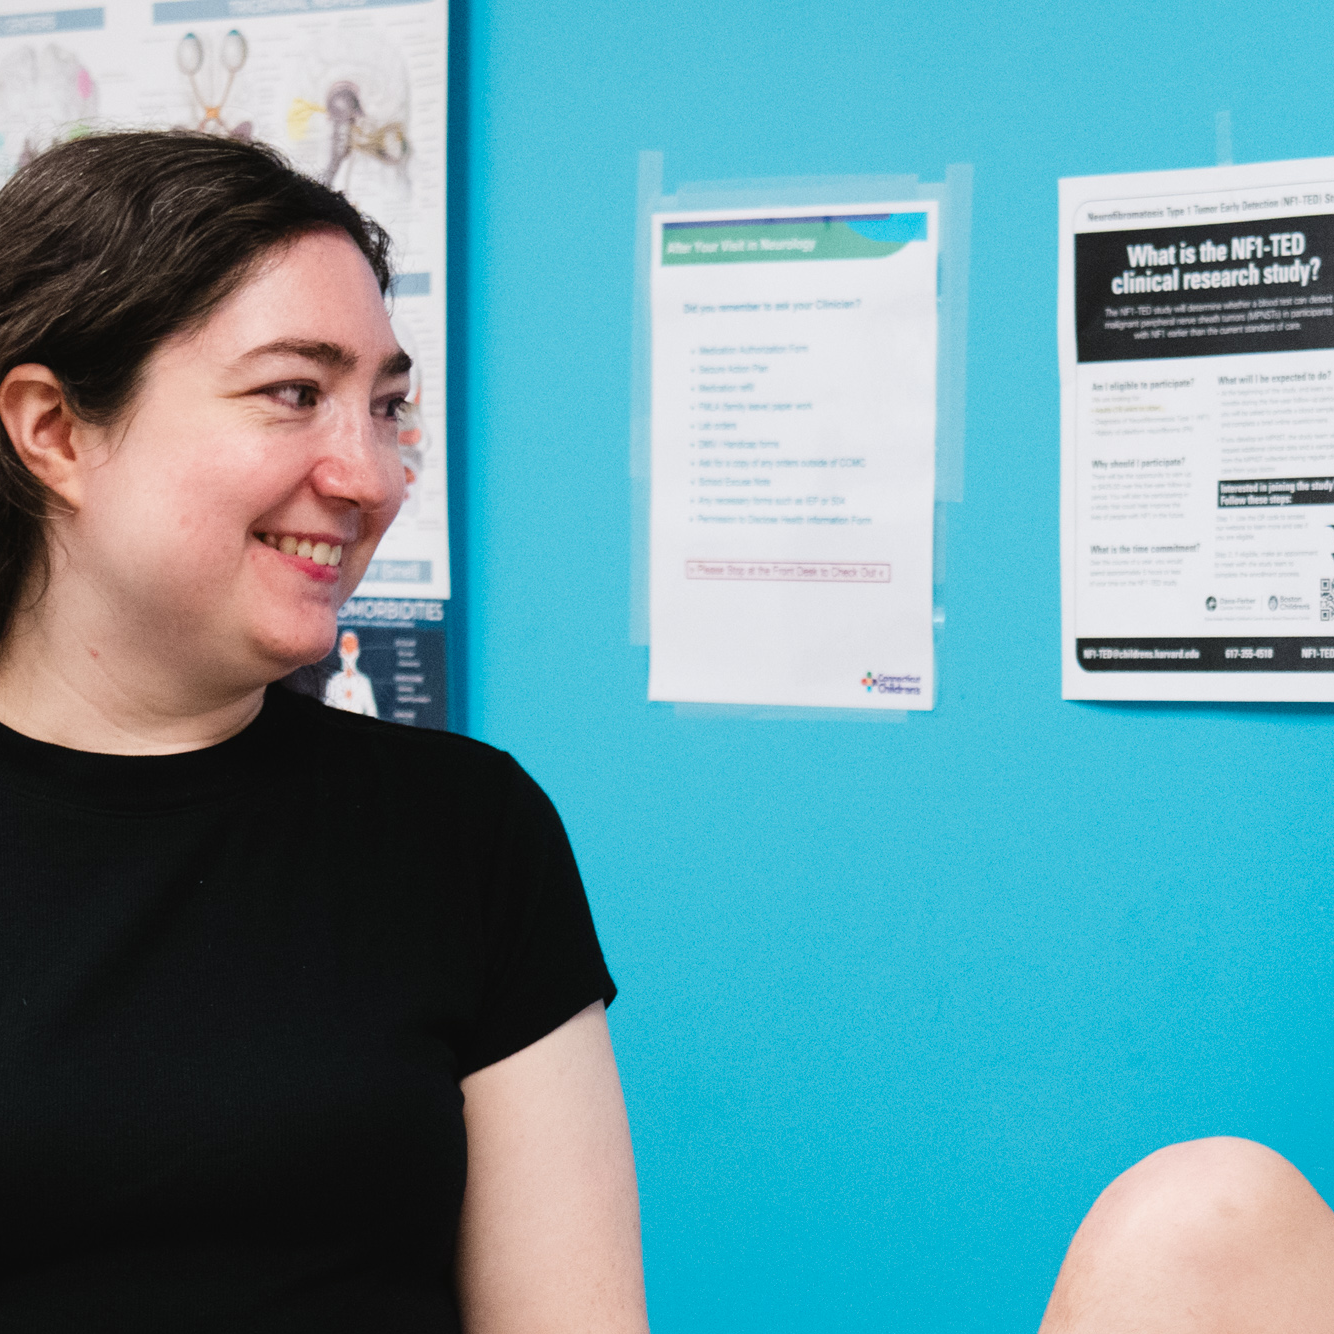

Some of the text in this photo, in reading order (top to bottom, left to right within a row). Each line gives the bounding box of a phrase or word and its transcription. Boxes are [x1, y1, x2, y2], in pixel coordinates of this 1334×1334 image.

[1167, 205, 1185, 218] Type
[1220, 201, 1240, 214] Early
[1242, 198, 1279, 211] Detection
[1127, 232, 1306, 267] What is the NF1-TED
[1111, 256, 1322, 295] clinical research study?
